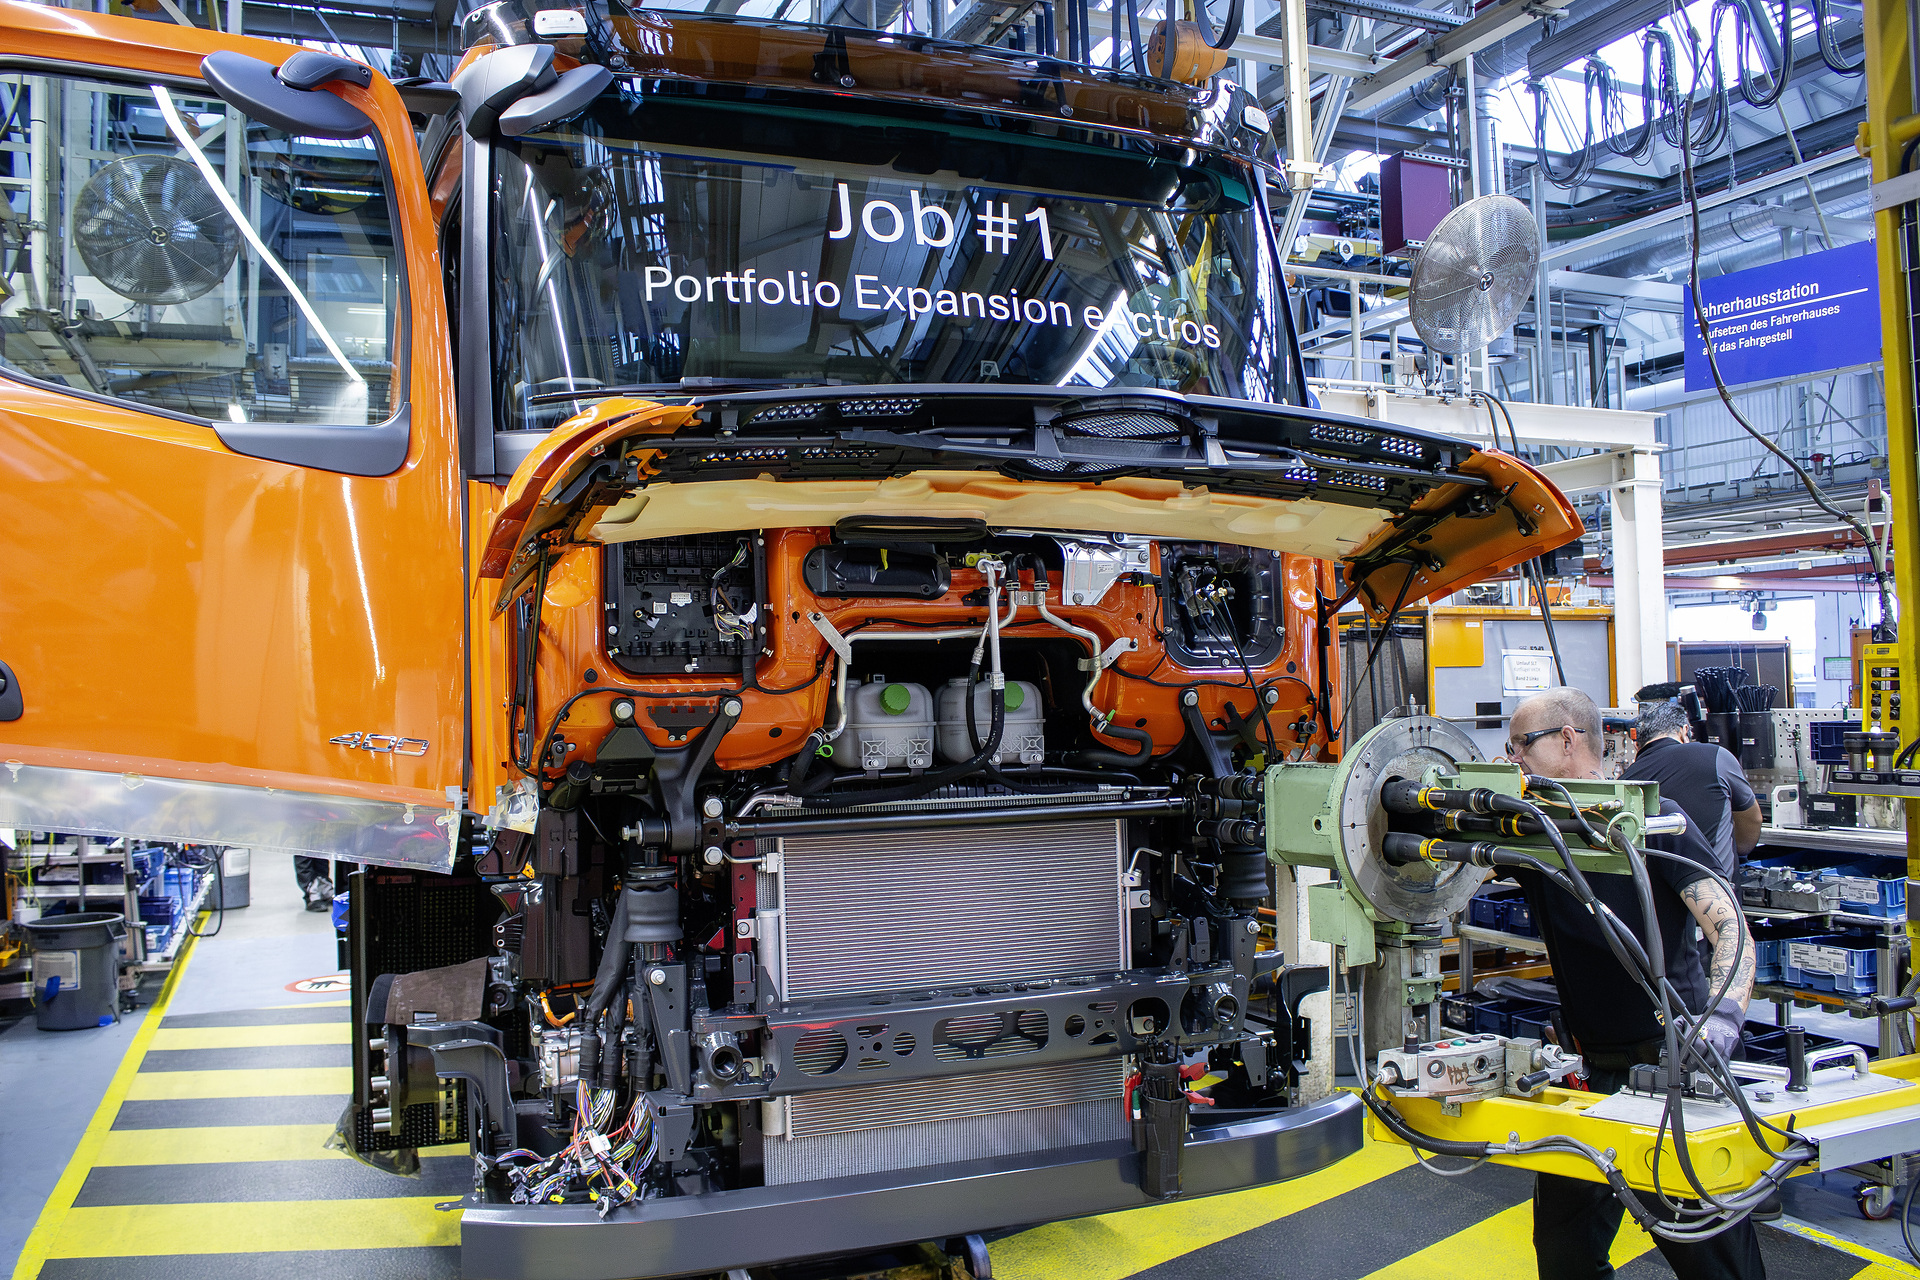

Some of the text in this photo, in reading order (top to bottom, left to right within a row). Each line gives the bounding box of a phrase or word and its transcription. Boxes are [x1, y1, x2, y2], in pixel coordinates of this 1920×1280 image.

[829, 183, 1054, 260] Job #1
[644, 261, 841, 307] Portfolio
[854, 275, 1073, 327] Expansion
[1701, 305, 1840, 341] ufsetzen des Fahrerhauses
[1702, 328, 1793, 356] af das Fahrgestell
